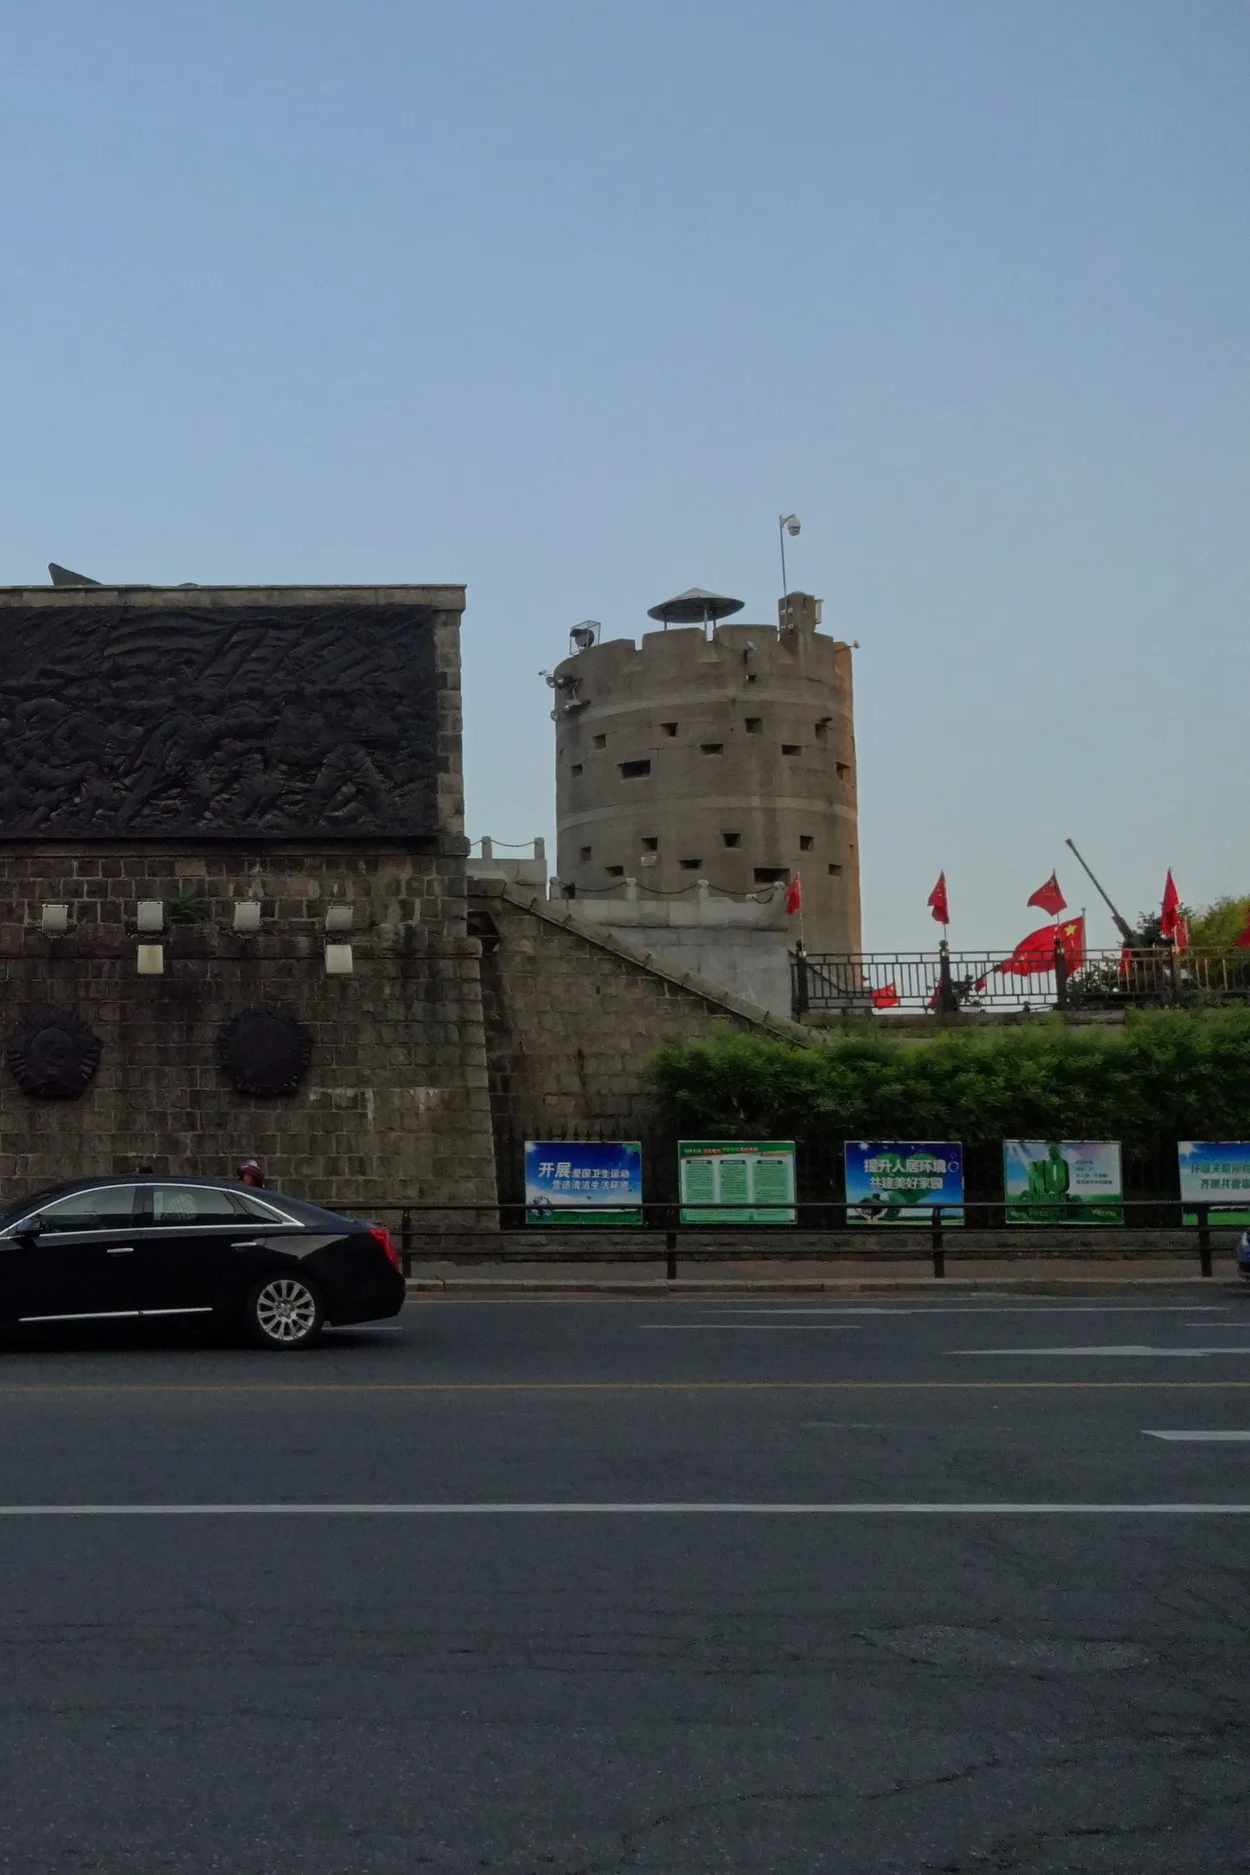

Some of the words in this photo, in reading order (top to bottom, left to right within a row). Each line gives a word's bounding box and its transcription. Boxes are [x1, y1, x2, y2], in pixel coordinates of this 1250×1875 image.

[863, 1158, 946, 1173] 提升人居环境
